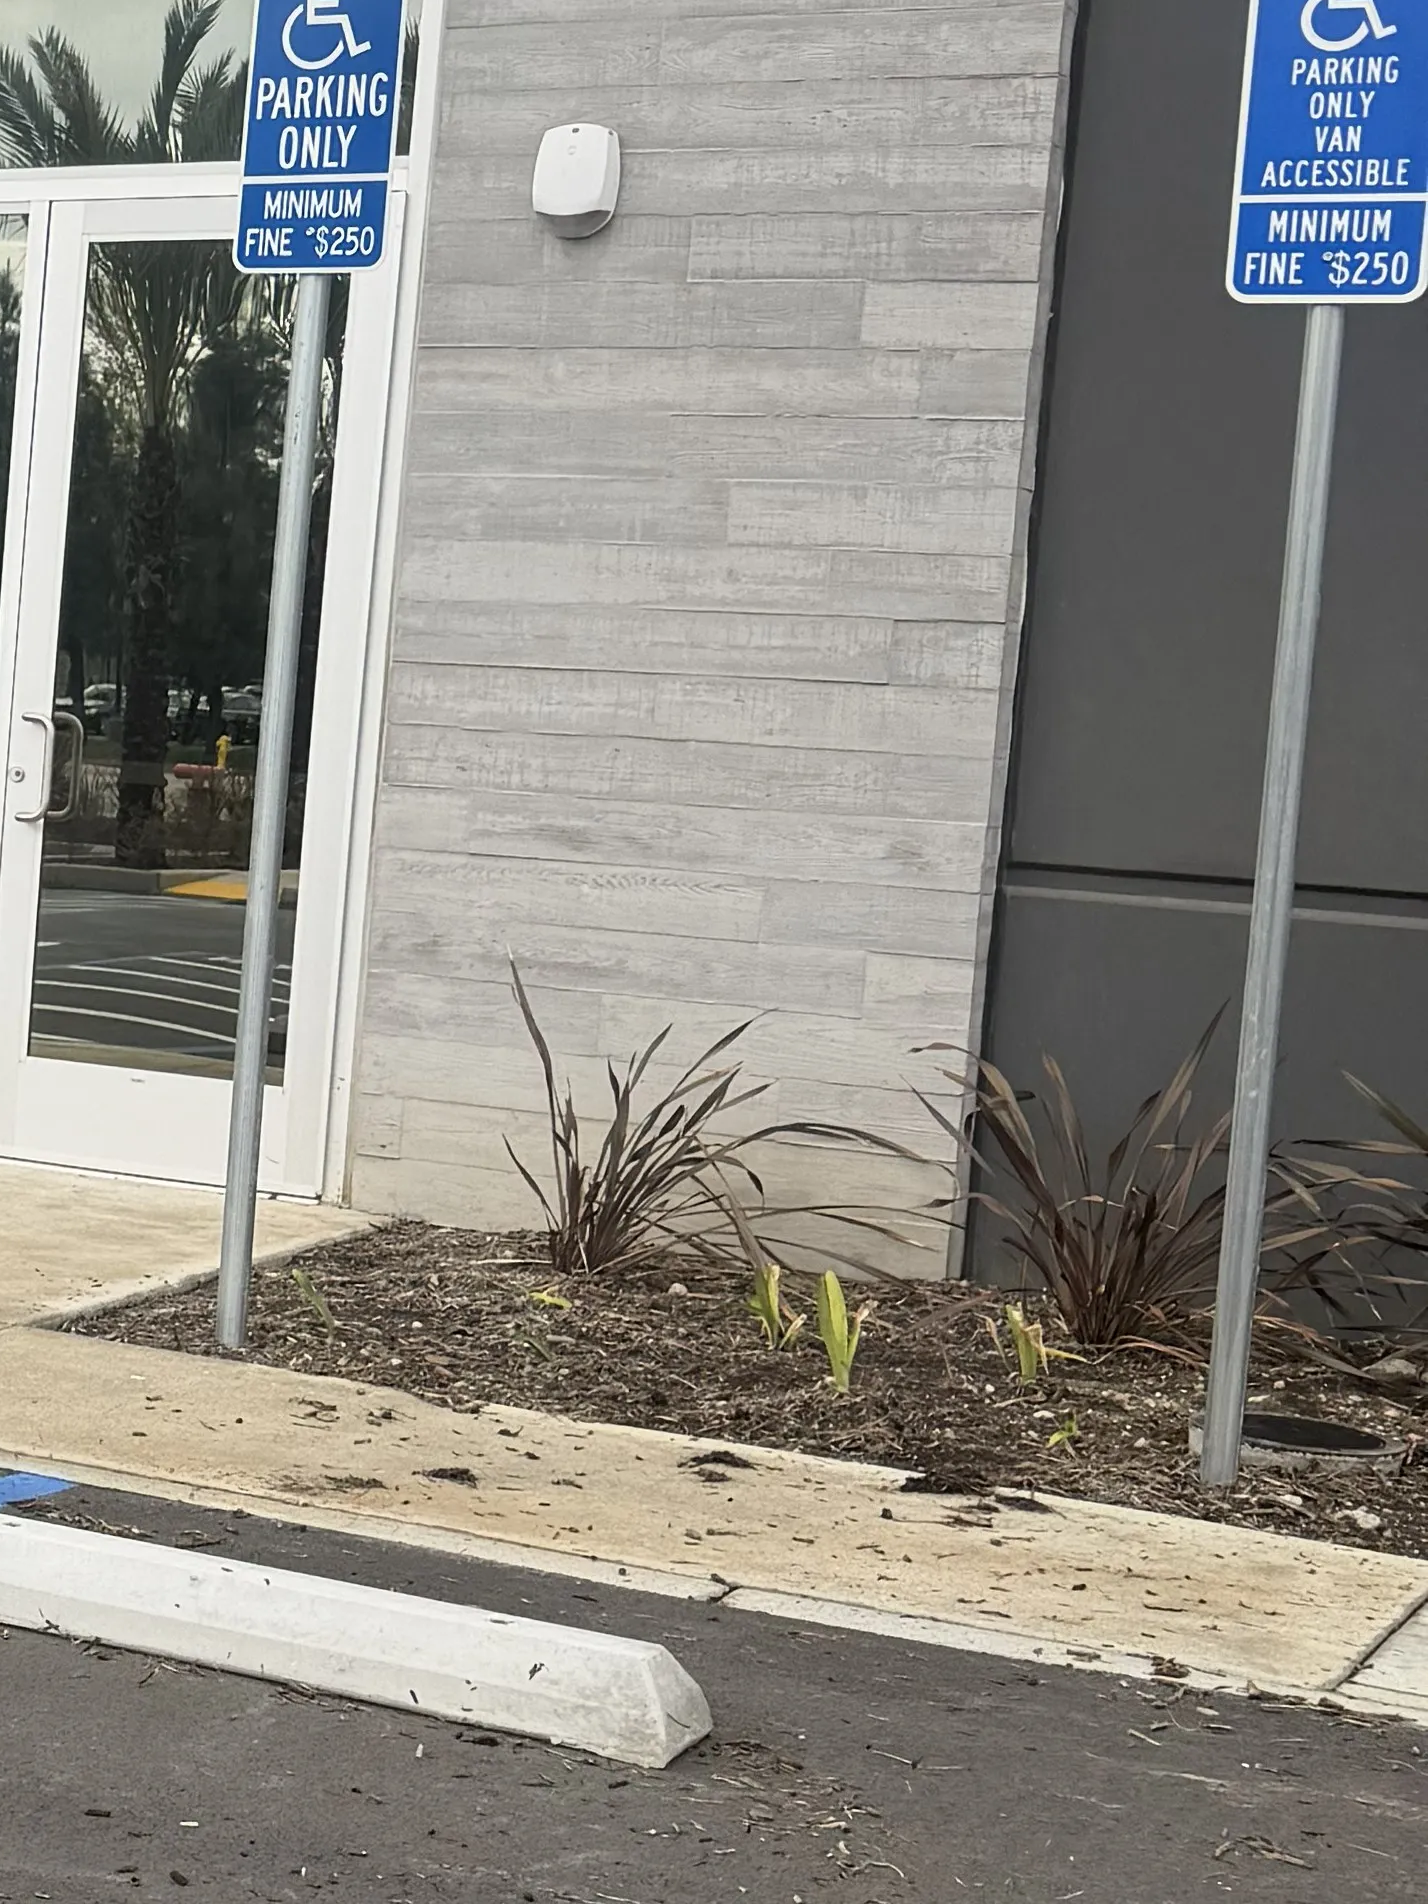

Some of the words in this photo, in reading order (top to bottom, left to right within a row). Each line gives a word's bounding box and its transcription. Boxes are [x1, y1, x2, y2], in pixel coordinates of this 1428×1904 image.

[1291, 56, 1399, 85] PARKING
[256, 72, 388, 120] PARKING
[1309, 91, 1375, 119] ONLY
[279, 125, 357, 169] ONLY
[1315, 126, 1362, 152] VAN
[1261, 158, 1410, 188] ACCESSIBLE
[264, 188, 362, 219] MINIMUM
[245, 227, 293, 257] FINE
[314, 225, 375, 259] $250
[1268, 209, 1392, 243] MINIMUM
[1244, 252, 1304, 286] FINE
[1328, 249, 1409, 288] $250
